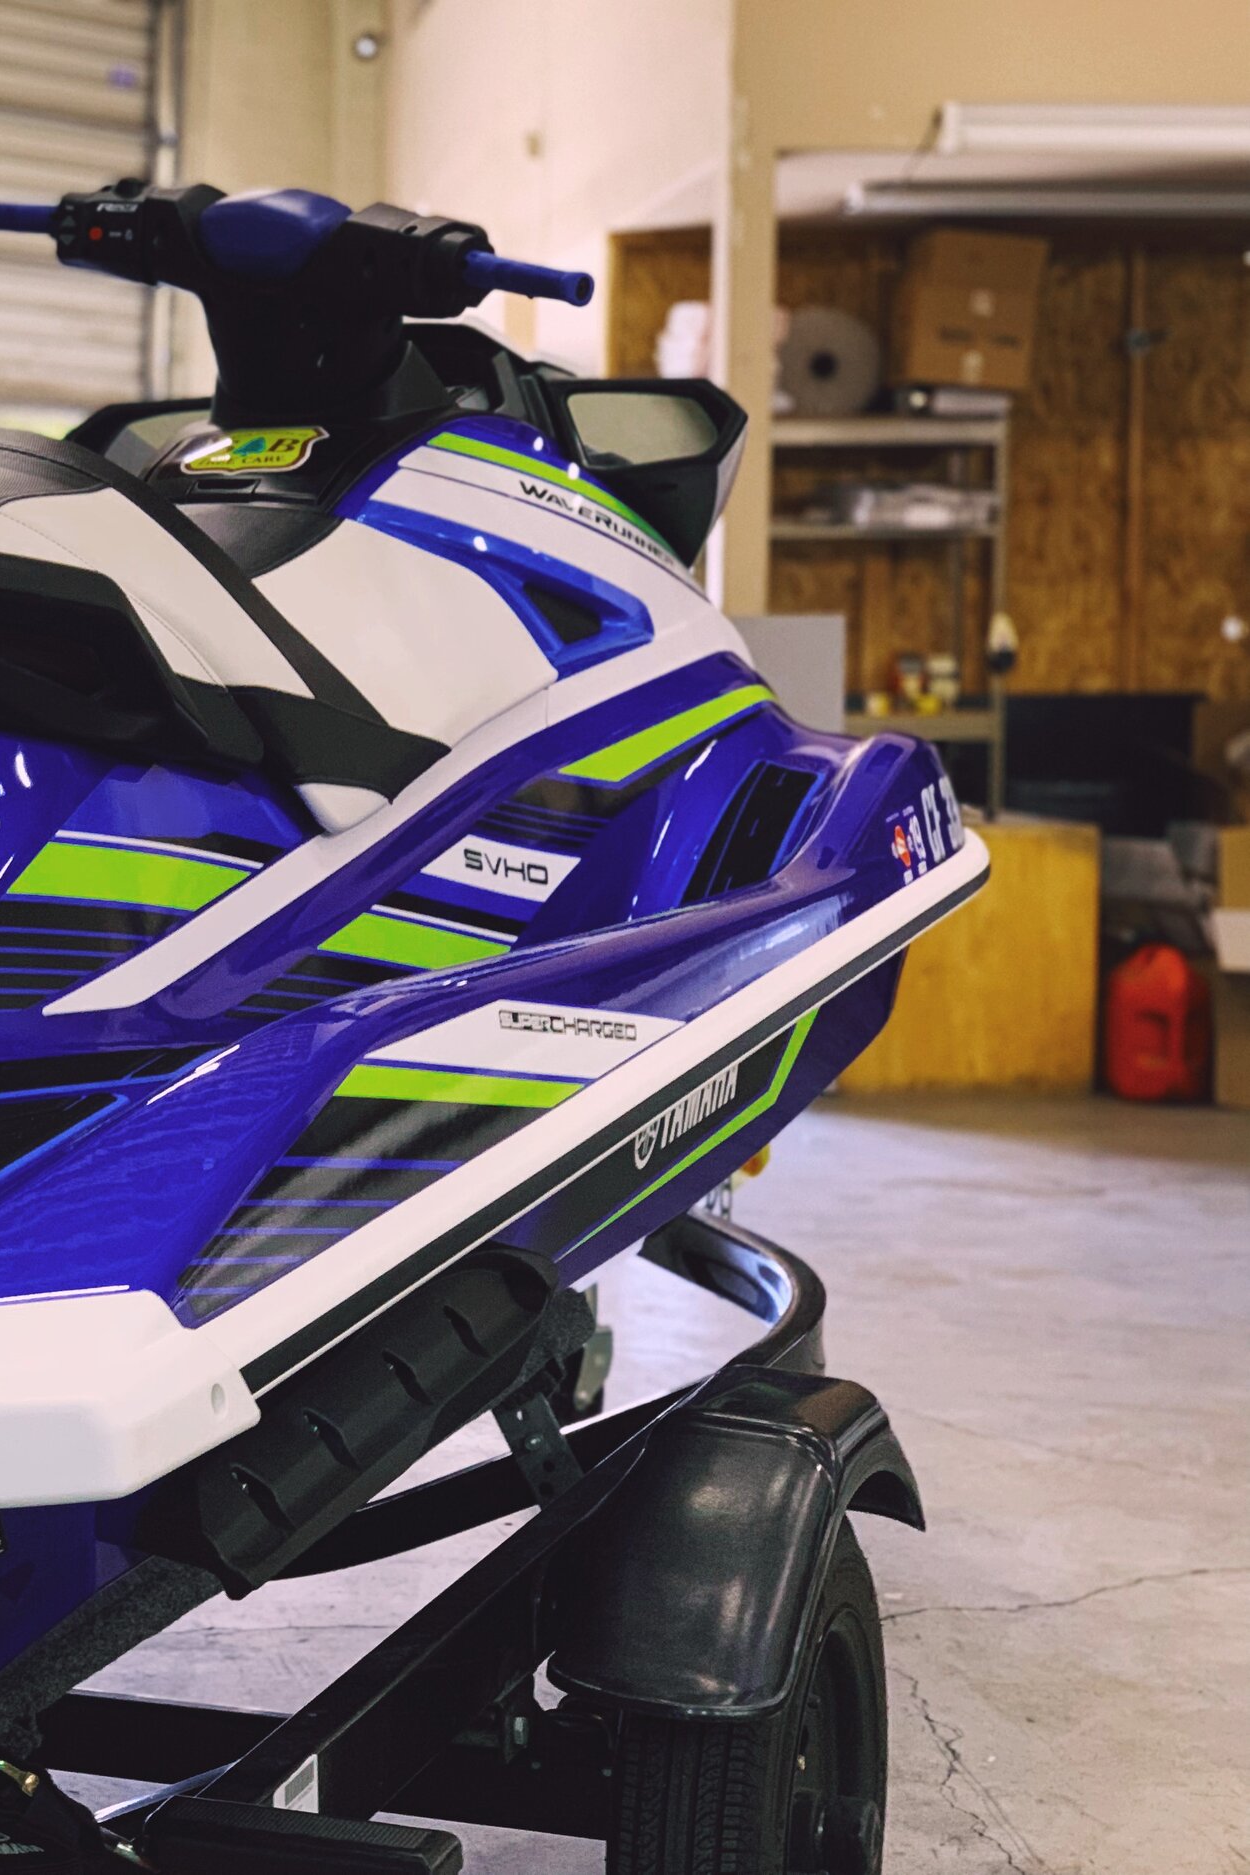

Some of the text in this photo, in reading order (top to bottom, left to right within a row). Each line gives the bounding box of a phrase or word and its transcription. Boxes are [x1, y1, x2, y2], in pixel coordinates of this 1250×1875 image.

[242, 455, 286, 465] CARE
[921, 783, 946, 863] CF
[463, 848, 549, 886] SVHO
[498, 1010, 638, 1041] SUPERCHARGED
